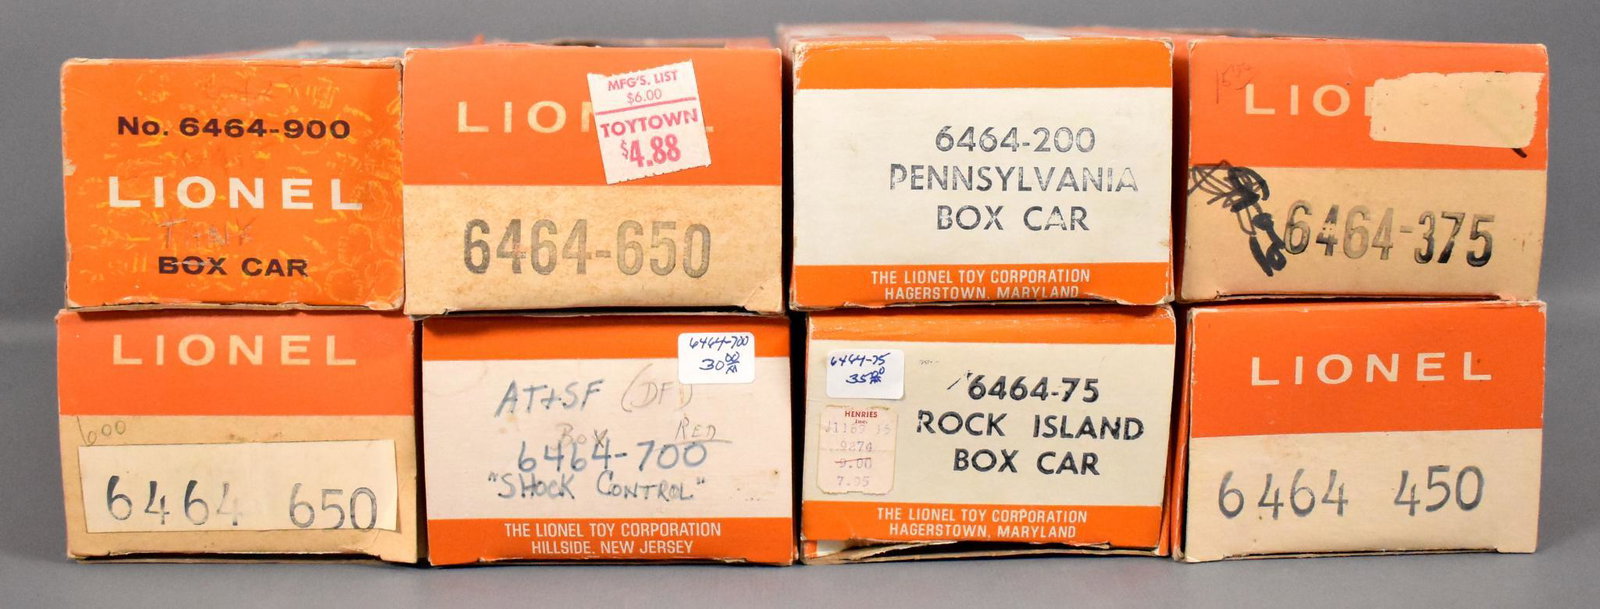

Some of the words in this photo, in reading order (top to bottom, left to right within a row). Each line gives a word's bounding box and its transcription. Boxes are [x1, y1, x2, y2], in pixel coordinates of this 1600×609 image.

[608, 74, 651, 91] MFG'S.
[654, 70, 678, 84] LIST
[627, 88, 662, 105] $6.00
[117, 116, 169, 135] No.
[179, 117, 351, 139] 6464-900
[458, 101, 714, 133] LIO
[600, 108, 699, 138] TOYTOWN
[621, 133, 682, 168] $4.88
[935, 126, 1096, 153] 6464-200
[889, 163, 1139, 192] PENNSYLVANIA
[108, 176, 363, 211] LIONEL
[936, 205, 1004, 230] BOX
[1023, 206, 1090, 231] CAR
[1283, 200, 1495, 267] 6464-375
[463, 218, 712, 278] 6464-650
[158, 256, 228, 275] BOX
[241, 258, 308, 277] CAR
[871, 271, 897, 284] THE
[904, 271, 953, 284] LIONEL
[958, 270, 984, 284] TOY
[990, 269, 1090, 283] CORPORATION
[996, 286, 1079, 299] MARYLAND
[112, 334, 357, 366] LIONEL
[1251, 351, 1492, 386] LIONEL
[967, 375, 1099, 402] 6464-75
[844, 410, 878, 418] HENRIES
[917, 410, 1007, 437] ROCK
[1033, 414, 1144, 441] ISLAND
[674, 416, 717, 441] RED
[518, 440, 708, 473] 6464-700
[953, 449, 1018, 473] BOX
[1036, 452, 1100, 476] CAR
[107, 475, 243, 526] 6464
[289, 483, 378, 532] 650
[1218, 468, 1348, 520] 6464
[1394, 465, 1485, 516] 450
[877, 508, 902, 521] THE
[908, 508, 955, 522] LIONEL
[960, 509, 985, 522] TOY
[991, 509, 1088, 524] CORPORATION
[505, 523, 530, 537] THE
[536, 523, 584, 537] LIONEL
[590, 523, 615, 537] TOY
[621, 523, 722, 537] CORPORATION
[997, 525, 1077, 539] MARYLAND
[601, 541, 634, 554] NEW
[639, 540, 694, 554] JERSEY
